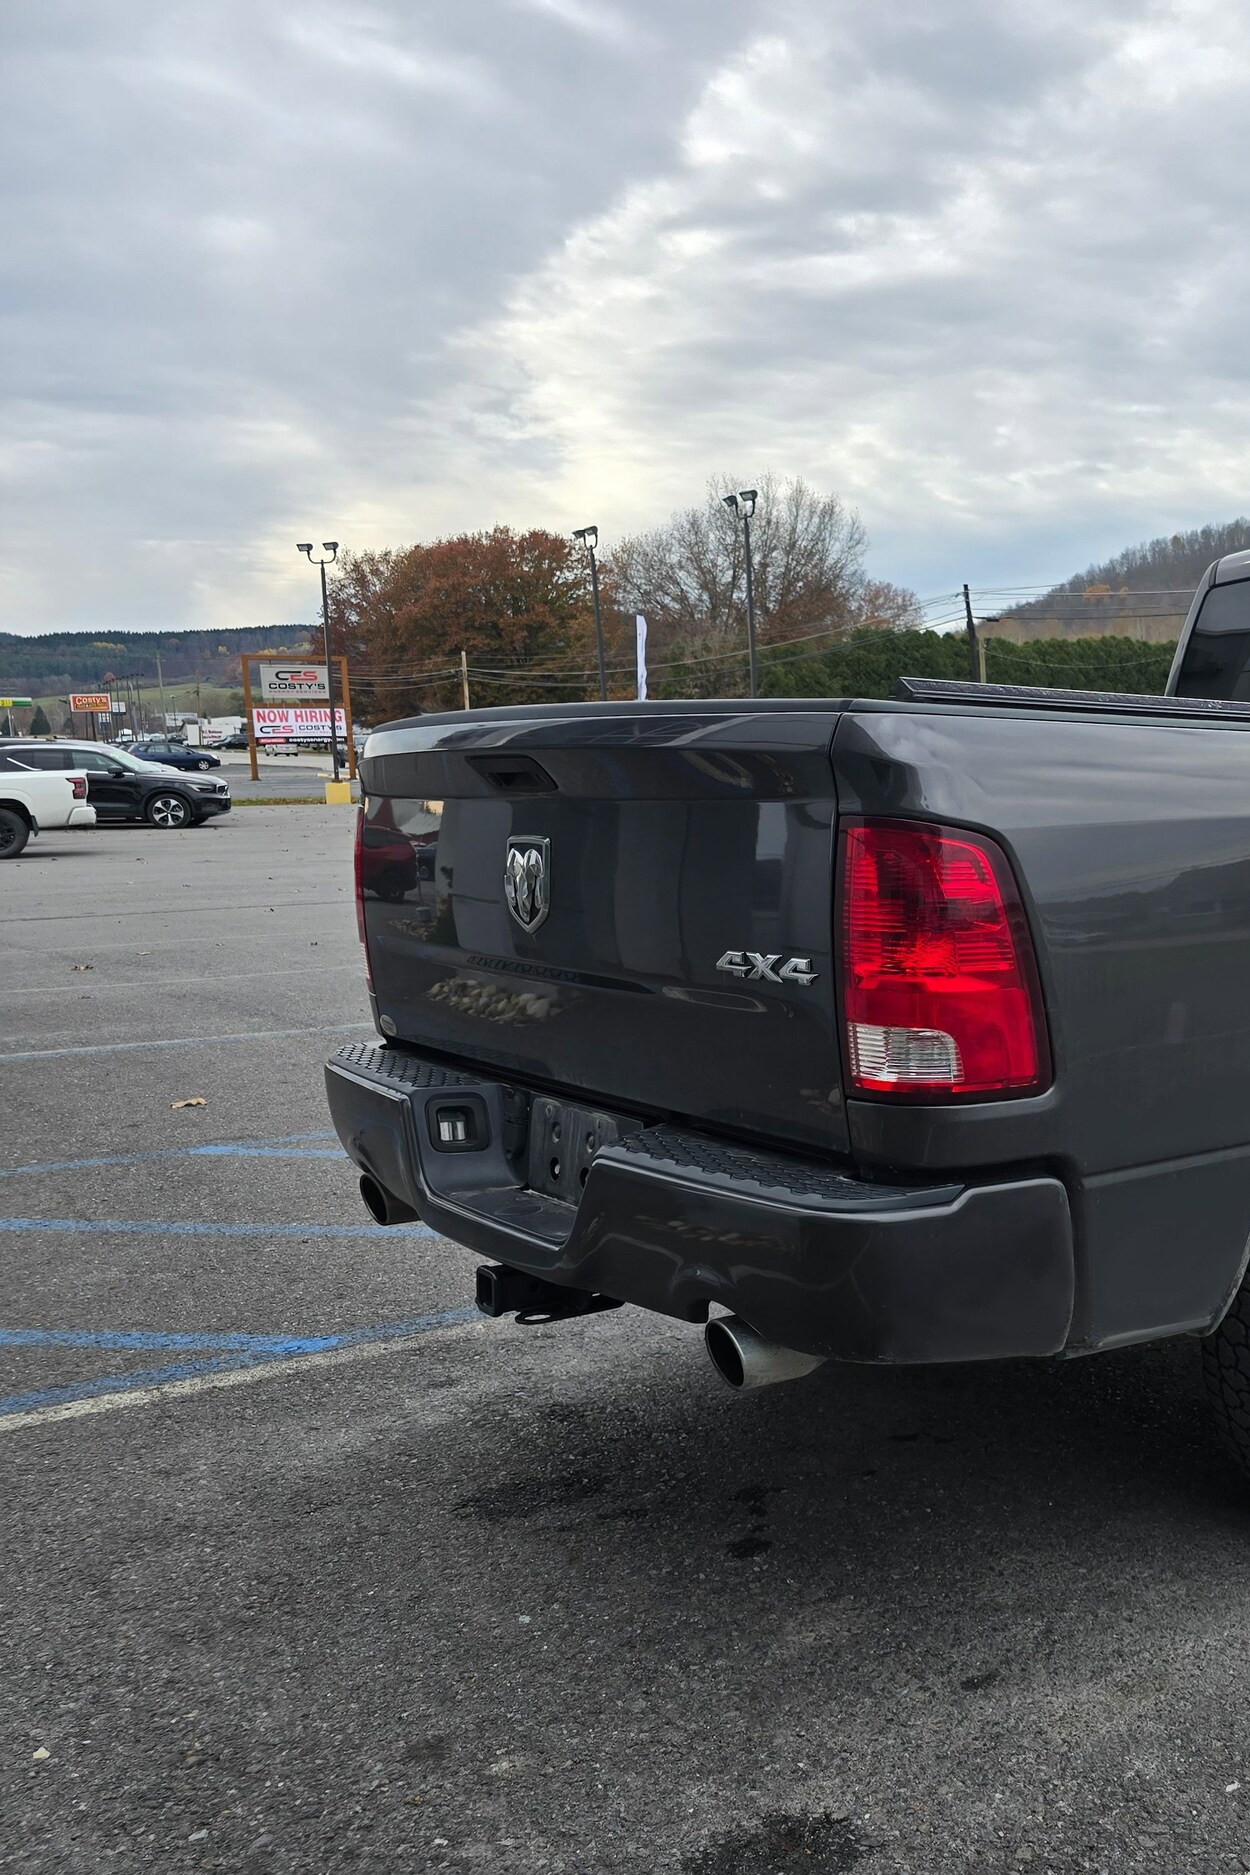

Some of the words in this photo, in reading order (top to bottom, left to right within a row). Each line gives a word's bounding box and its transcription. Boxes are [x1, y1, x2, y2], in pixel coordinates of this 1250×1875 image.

[275, 670, 318, 682] CES
[268, 682, 326, 690] COSTY'S
[75, 696, 107, 704] Costy's
[256, 710, 289, 723] NOW
[294, 710, 342, 722] HIRING
[260, 725, 294, 734] CES
[716, 951, 820, 986] 4X4
